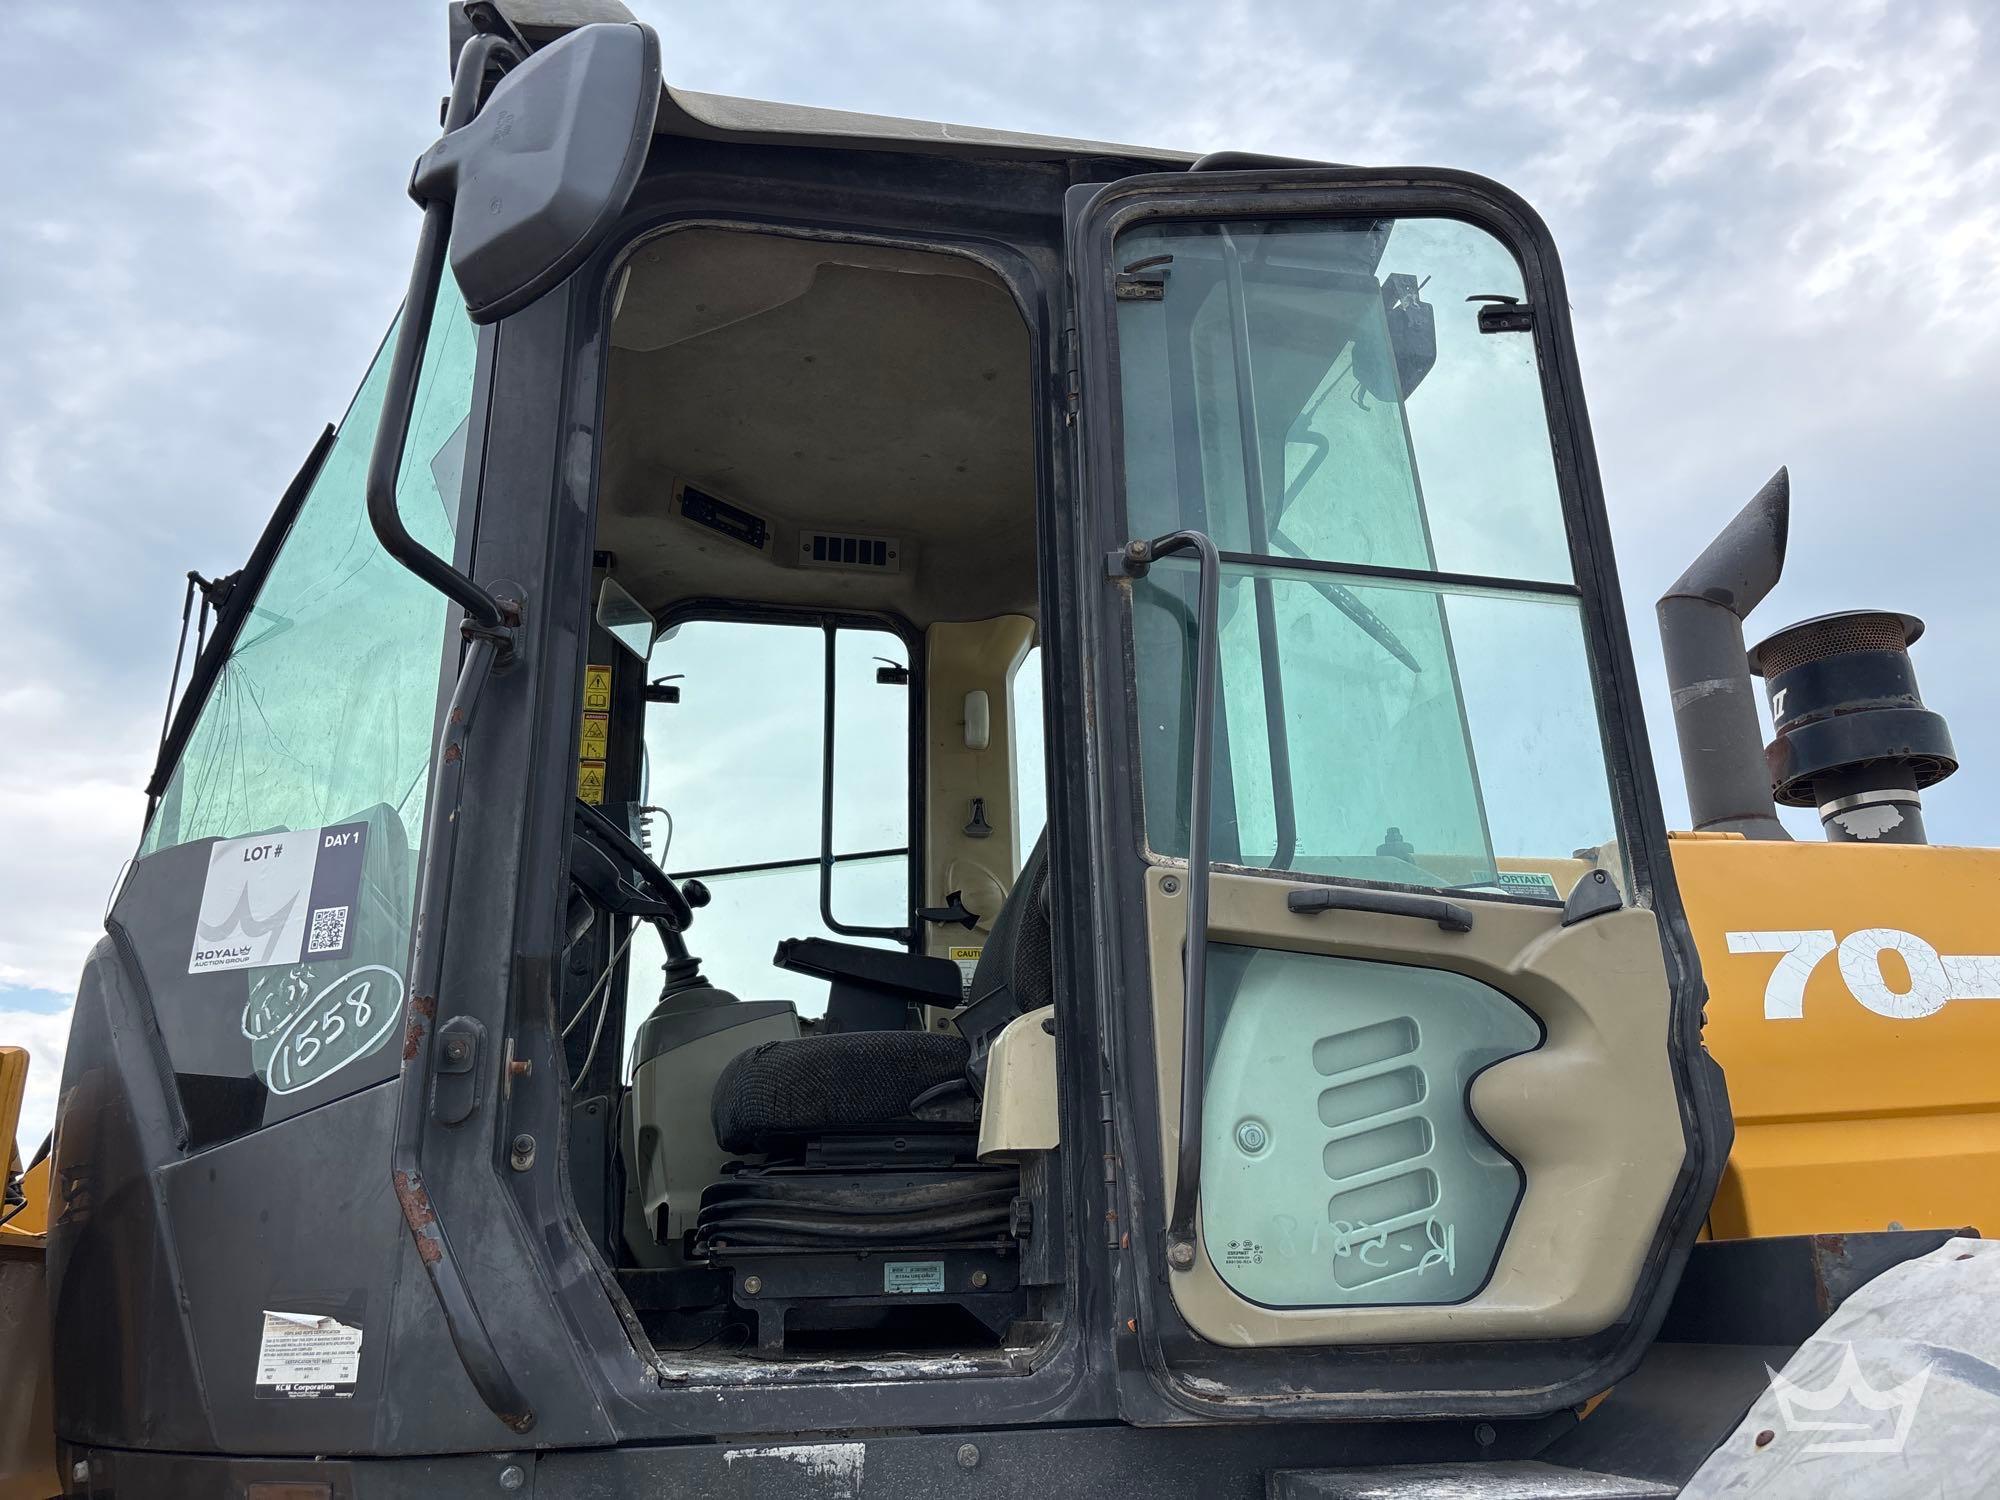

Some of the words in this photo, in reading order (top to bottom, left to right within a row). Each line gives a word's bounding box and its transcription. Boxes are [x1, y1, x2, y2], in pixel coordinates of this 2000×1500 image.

[325, 834, 352, 848] DAY
[351, 832, 359, 844] 1
[243, 845, 272, 862] LOT
[274, 844, 283, 858] #
[195, 948, 239, 961] ROYAL
[195, 959, 224, 967] AUCTION
[225, 956, 250, 964] GROUP
[283, 981, 372, 1085] 1558
[293, 1383, 335, 1393] Corporation
